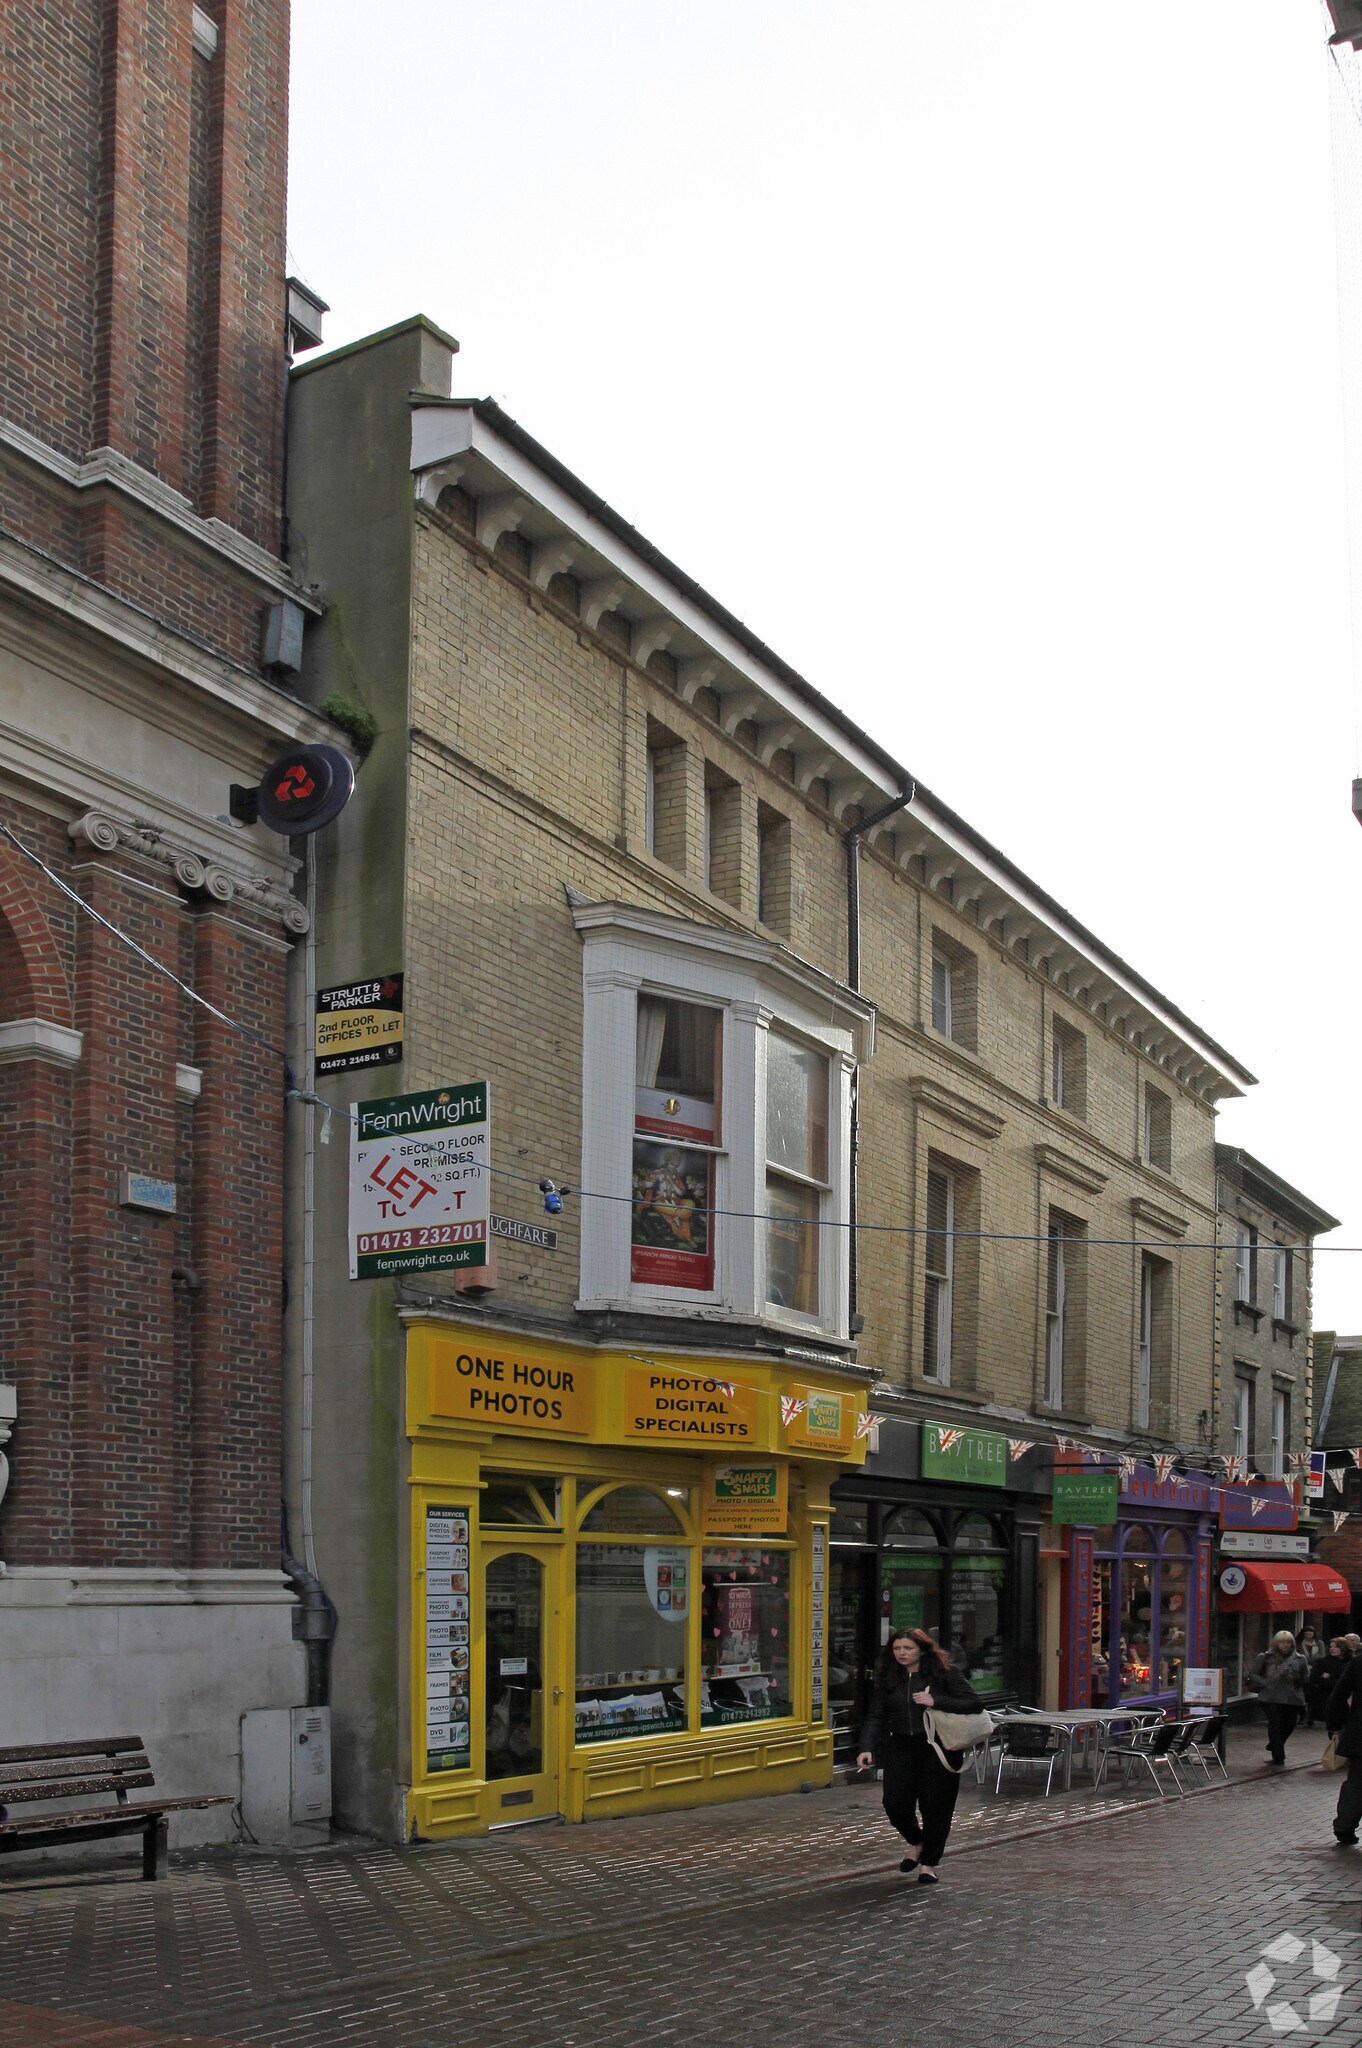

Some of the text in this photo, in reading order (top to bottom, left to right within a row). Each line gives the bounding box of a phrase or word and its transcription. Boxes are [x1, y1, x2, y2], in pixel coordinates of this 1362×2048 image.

[322, 983, 381, 1003] STRUTT &
[331, 992, 381, 1010] PARKER
[318, 1020, 400, 1044] OFFICES TO LET
[319, 1015, 374, 1033] 2nd FLOOR
[321, 1052, 380, 1069] 01473 214841
[362, 1096, 482, 1133] FennWright
[400, 1134, 485, 1156] SECOD FLOOR
[414, 1151, 474, 1169] PRMISES
[370, 1154, 438, 1209] LET
[445, 1167, 481, 1181] SQ.FT.)
[360, 1222, 482, 1252] 01473 232701
[491, 1216, 549, 1245] UGHFARE
[377, 1250, 470, 1270] fennwright.co.uk
[456, 1354, 574, 1392] ONE HOUR
[650, 1376, 717, 1393] PHOTO
[470, 1388, 562, 1420] PHOTOS
[656, 1397, 729, 1414] DIGITAL
[634, 1417, 749, 1436] SPECIALISTS
[828, 1443, 851, 1452] SPECIALISTS
[723, 1470, 773, 1487] SNAPPY
[730, 1483, 771, 1496] SNAPS
[1057, 1486, 1113, 1494] BAYTREE
[728, 1619, 752, 1629] ONE!
